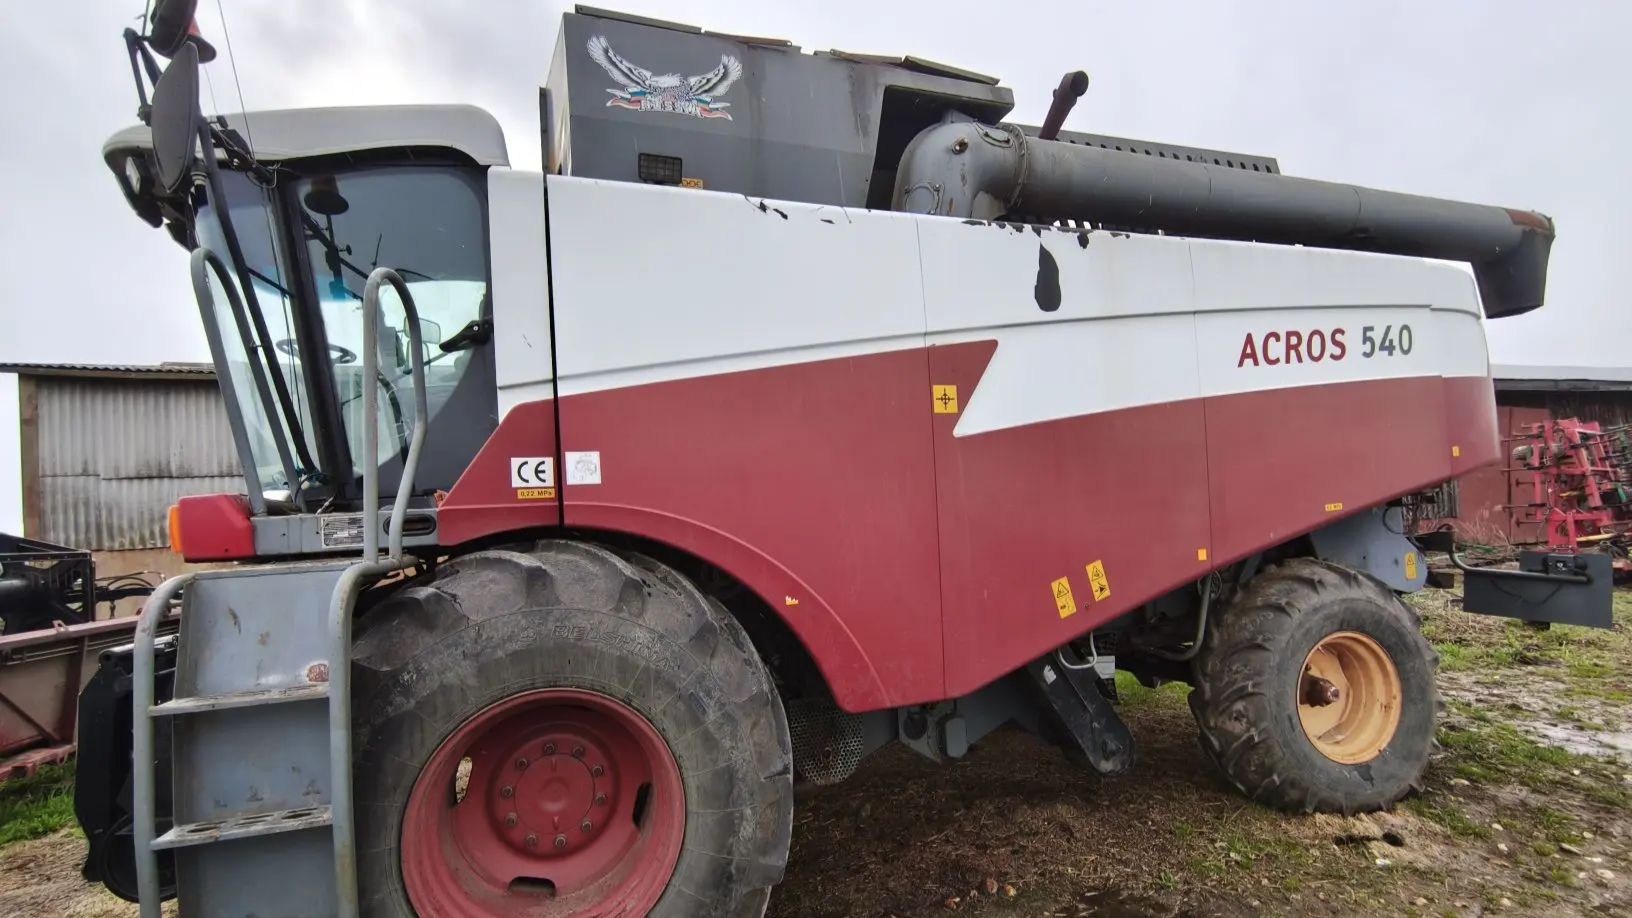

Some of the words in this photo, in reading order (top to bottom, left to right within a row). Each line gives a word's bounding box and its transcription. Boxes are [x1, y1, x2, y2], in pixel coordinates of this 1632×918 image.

[1237, 328, 1347, 368] ACROS
[1361, 324, 1413, 359] 540
[517, 461, 546, 483] CE
